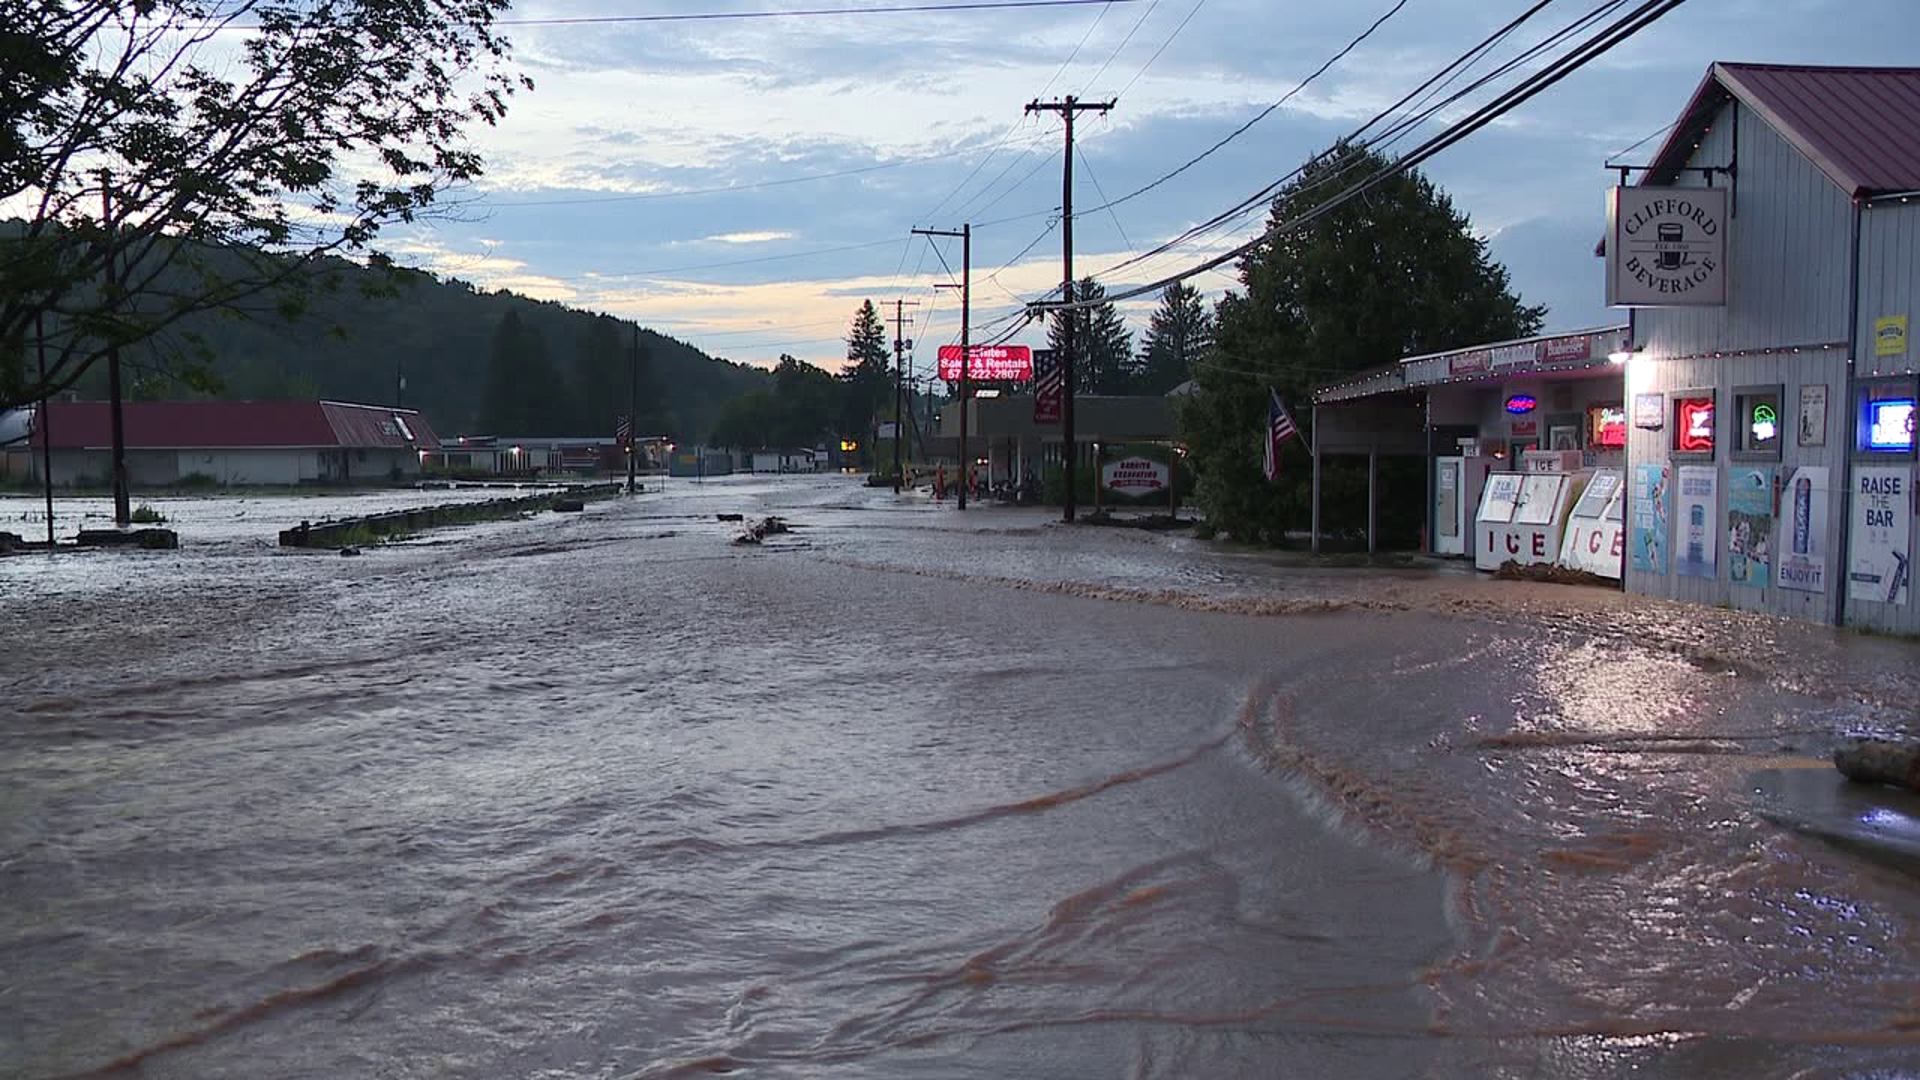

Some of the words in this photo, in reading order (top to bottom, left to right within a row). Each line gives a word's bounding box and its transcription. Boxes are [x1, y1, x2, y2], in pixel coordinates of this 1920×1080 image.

[1625, 199, 1717, 236] CLIFFORD
[1626, 257, 1716, 293] BEVERAGE
[974, 359, 983, 369] &
[986, 358, 1028, 369] Rentals
[947, 369, 1021, 380] 57-222-2807
[1536, 460, 1553, 470] ICE
[1861, 477, 1901, 495] RAISE
[1872, 495, 1889, 509] THE
[1866, 509, 1894, 527] BAR
[1489, 530, 1546, 556] ICE
[1571, 527, 1623, 557] ICE
[1780, 567, 1810, 583] ENJOY
[1811, 571, 1822, 584] IT
